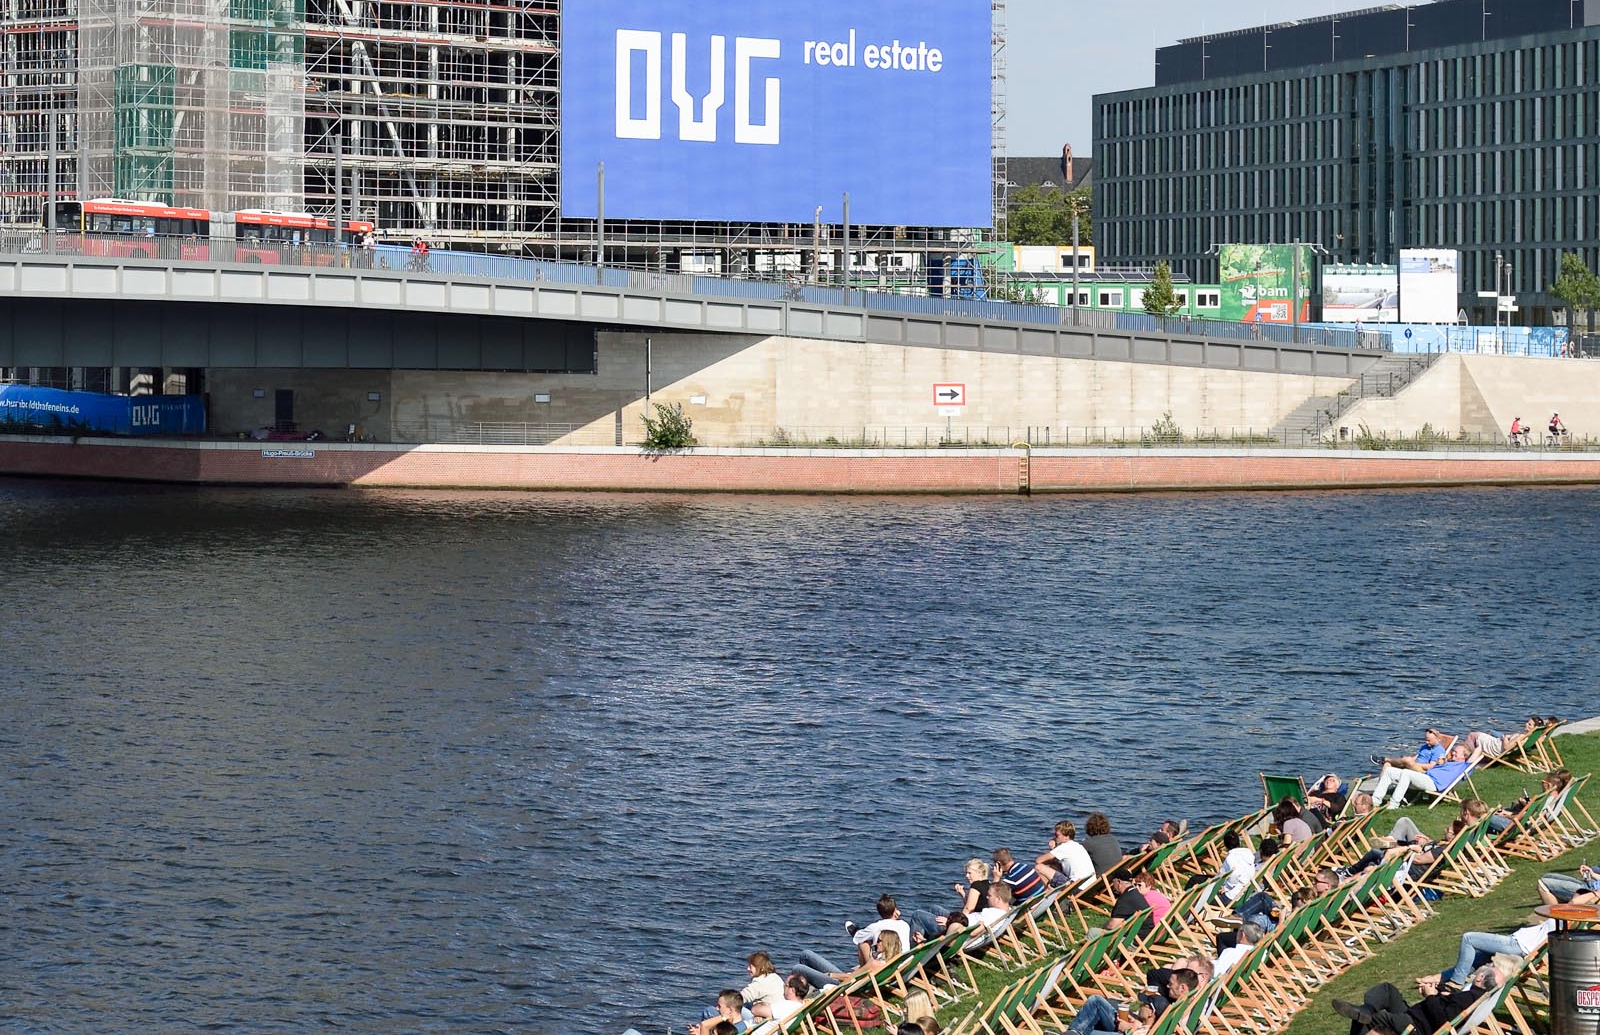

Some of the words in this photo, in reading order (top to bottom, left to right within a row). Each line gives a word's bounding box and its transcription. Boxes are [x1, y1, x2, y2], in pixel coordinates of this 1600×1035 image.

[615, 28, 780, 145] OVG
[804, 28, 856, 67] real
[863, 39, 943, 73] estate
[1258, 284, 1288, 298] bam
